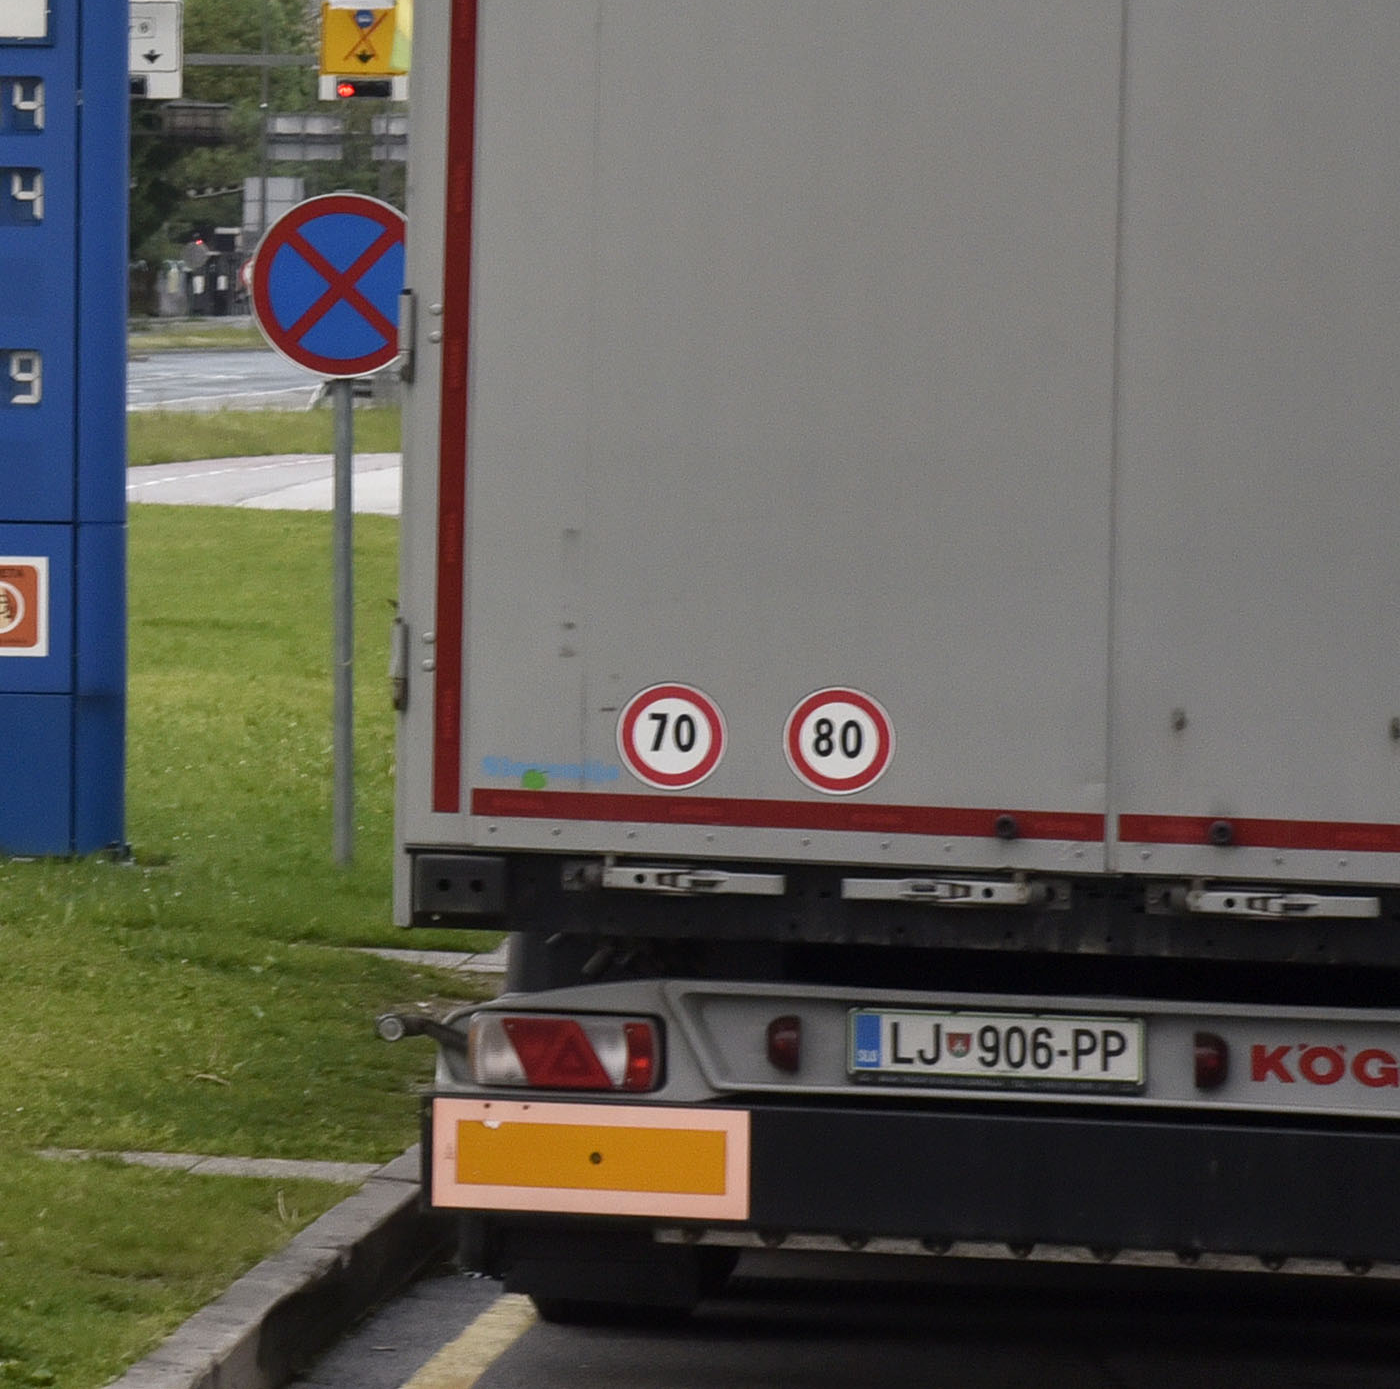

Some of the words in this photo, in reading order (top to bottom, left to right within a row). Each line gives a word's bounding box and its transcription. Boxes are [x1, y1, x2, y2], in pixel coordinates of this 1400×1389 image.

[647, 712, 696, 752] 70
[812, 717, 863, 759] 80
[890, 1021, 941, 1065] LJ
[977, 1025, 1127, 1072] 906-PP
